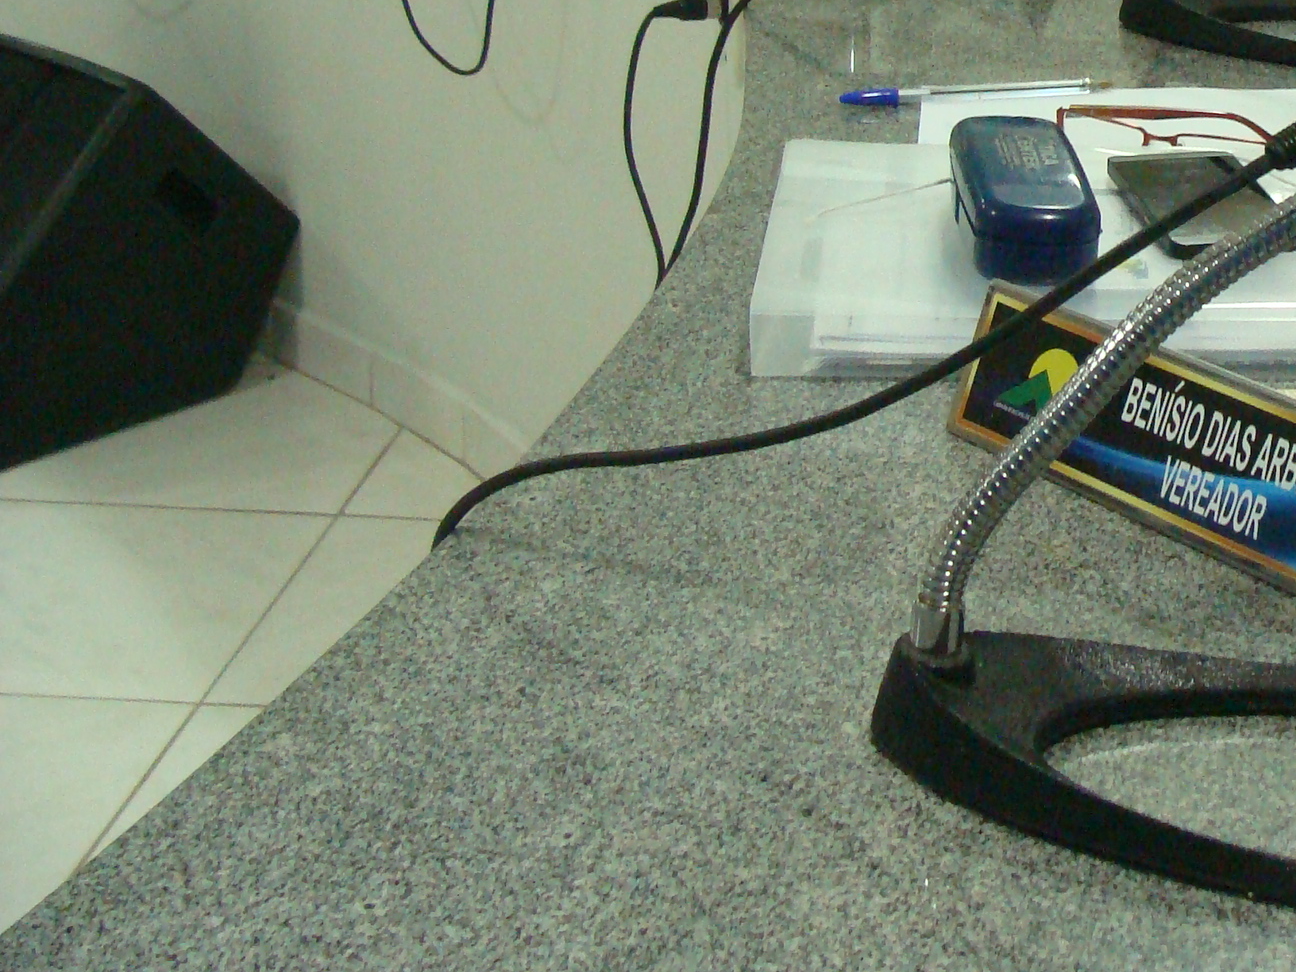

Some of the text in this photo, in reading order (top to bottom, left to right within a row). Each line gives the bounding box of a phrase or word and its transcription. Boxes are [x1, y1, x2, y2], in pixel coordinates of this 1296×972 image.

[1121, 377, 1206, 450] BENÍSIO
[1201, 410, 1257, 472] DIAS
[1160, 454, 1268, 541] VEREADOR
